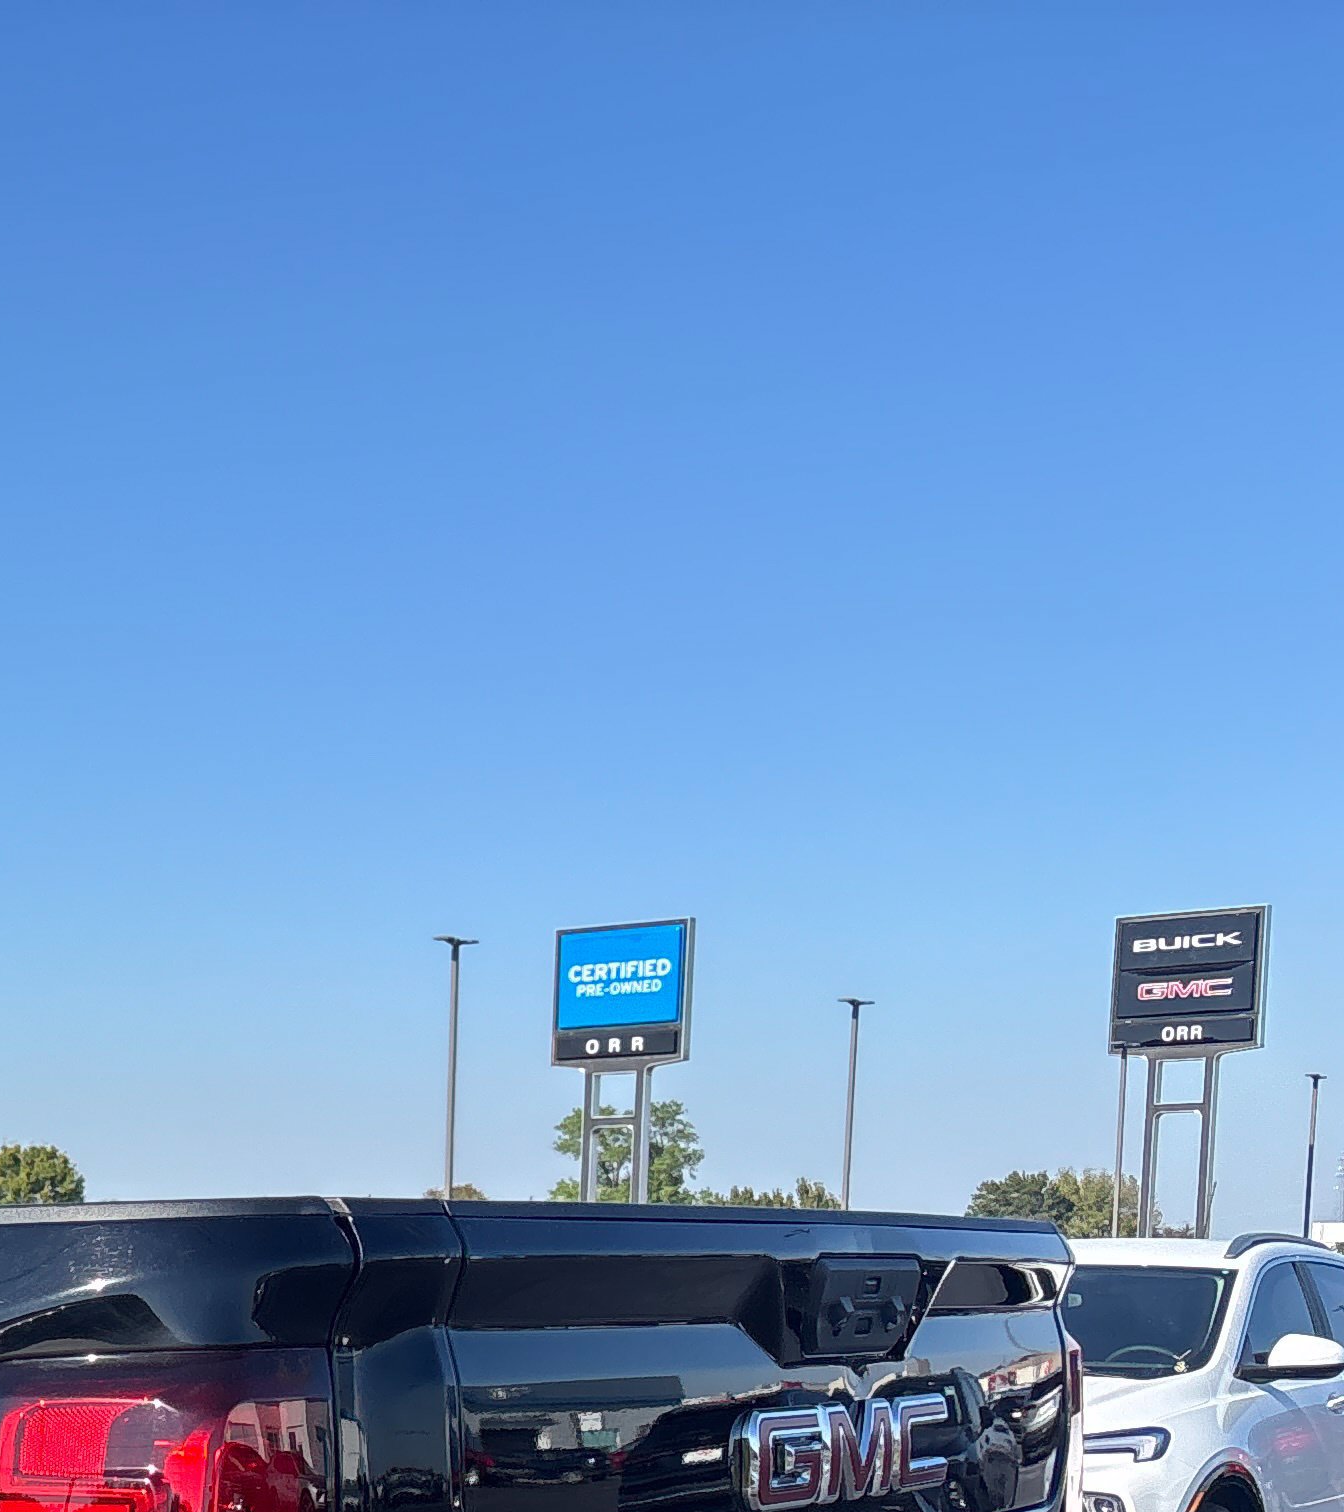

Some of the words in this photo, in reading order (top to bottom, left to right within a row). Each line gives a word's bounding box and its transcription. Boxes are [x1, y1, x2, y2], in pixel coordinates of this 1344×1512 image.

[1133, 932, 1243, 953] BUICK
[568, 958, 672, 983] CERTIFIED
[575, 979, 662, 998] PRE-OWNED
[1137, 977, 1234, 1001] GMC
[1162, 1024, 1203, 1042] ORR
[585, 1036, 644, 1054] ORR
[730, 1392, 949, 1511] GMC
